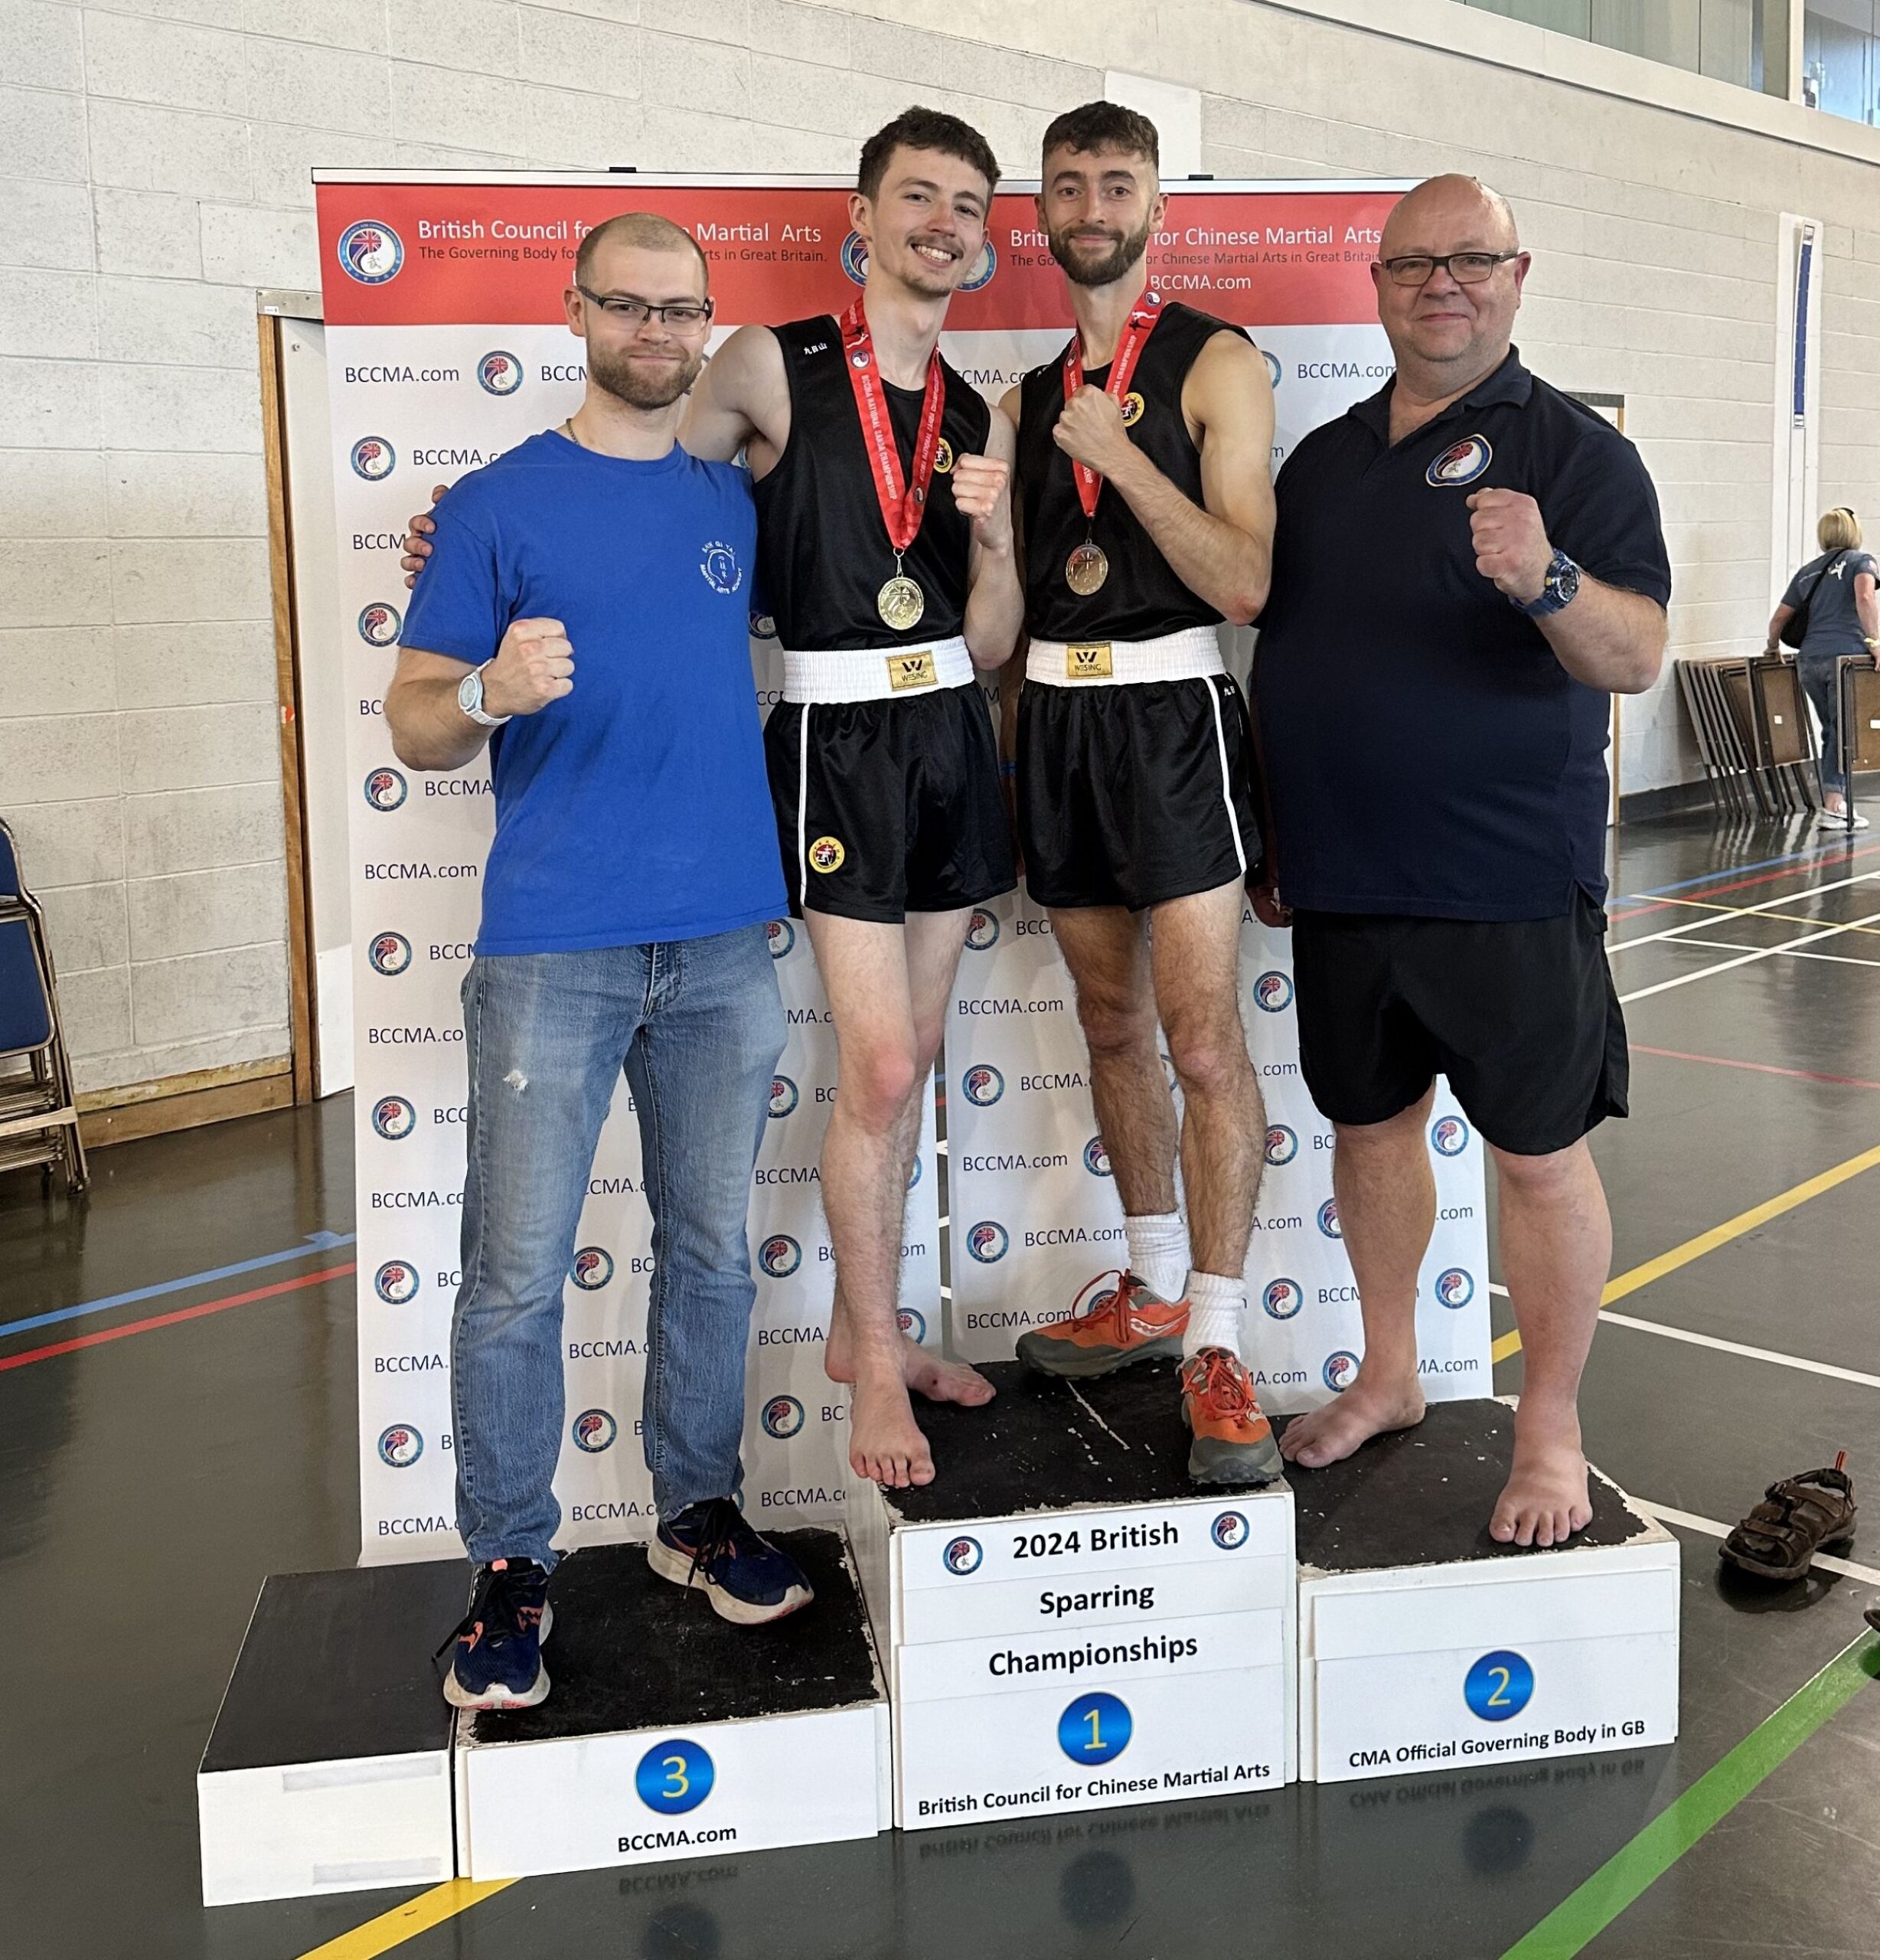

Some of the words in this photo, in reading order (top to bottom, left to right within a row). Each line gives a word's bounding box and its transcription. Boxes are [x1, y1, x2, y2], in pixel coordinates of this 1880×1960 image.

[418, 220, 485, 240] British
[491, 220, 568, 240] Council
[573, 220, 592, 240] fo
[697, 223, 769, 242] Martial
[781, 224, 822, 243] Arts
[1010, 229, 1049, 247] Briti
[1185, 227, 1259, 246] Chinese
[1265, 226, 1333, 245] Martial
[1344, 227, 1382, 243] Arts
[419, 247, 444, 260] The
[449, 247, 519, 262] Governing
[524, 248, 556, 261] Body
[725, 248, 736, 261] in
[740, 248, 776, 261] Great
[781, 250, 827, 262] Britain.
[1010, 254, 1034, 266] The
[1162, 253, 1210, 264] Chinese
[1214, 252, 1258, 264] Martial
[1263, 251, 1288, 263] Arts
[1291, 251, 1302, 263] in
[1306, 250, 1340, 262] Great
[1151, 274, 1252, 290] BCCMA.com
[345, 366, 459, 383] BCCMA.com
[426, 780, 493, 796] BCCMA
[364, 863, 478, 880] BCCMA.com
[958, 998, 1064, 1015] BCCMA.com
[369, 1027, 464, 1044] BCCMA.co
[962, 1152, 1068, 1172] BCCMA.com
[755, 1168, 821, 1185] BCCMA
[967, 1308, 1072, 1330] BCCMA.com
[572, 1502, 656, 1522] BCCMA.c
[1013, 1530, 1082, 1559] 2024
[1090, 1521, 1179, 1551] British
[1039, 1583, 1154, 1618] Sparring
[989, 1635, 1198, 1676] Championships
[1487, 1667, 1510, 1707] 2
[1082, 1708, 1108, 1750] 1
[1349, 1750, 1392, 1768] CMA
[1396, 1740, 1456, 1762] Official
[1461, 1732, 1549, 1755] Governing
[1554, 1725, 1597, 1746] Body
[1601, 1723, 1617, 1740] in
[1621, 1720, 1645, 1736] GB
[662, 1756, 690, 1798] 3
[919, 1793, 978, 1816] British
[983, 1786, 1051, 1809] Council
[1055, 1783, 1083, 1802] for
[1087, 1775, 1158, 1798] Chinese
[1163, 1766, 1229, 1788] Martial
[1233, 1762, 1271, 1780] Arts
[618, 1827, 736, 1853] BCCMA.com
